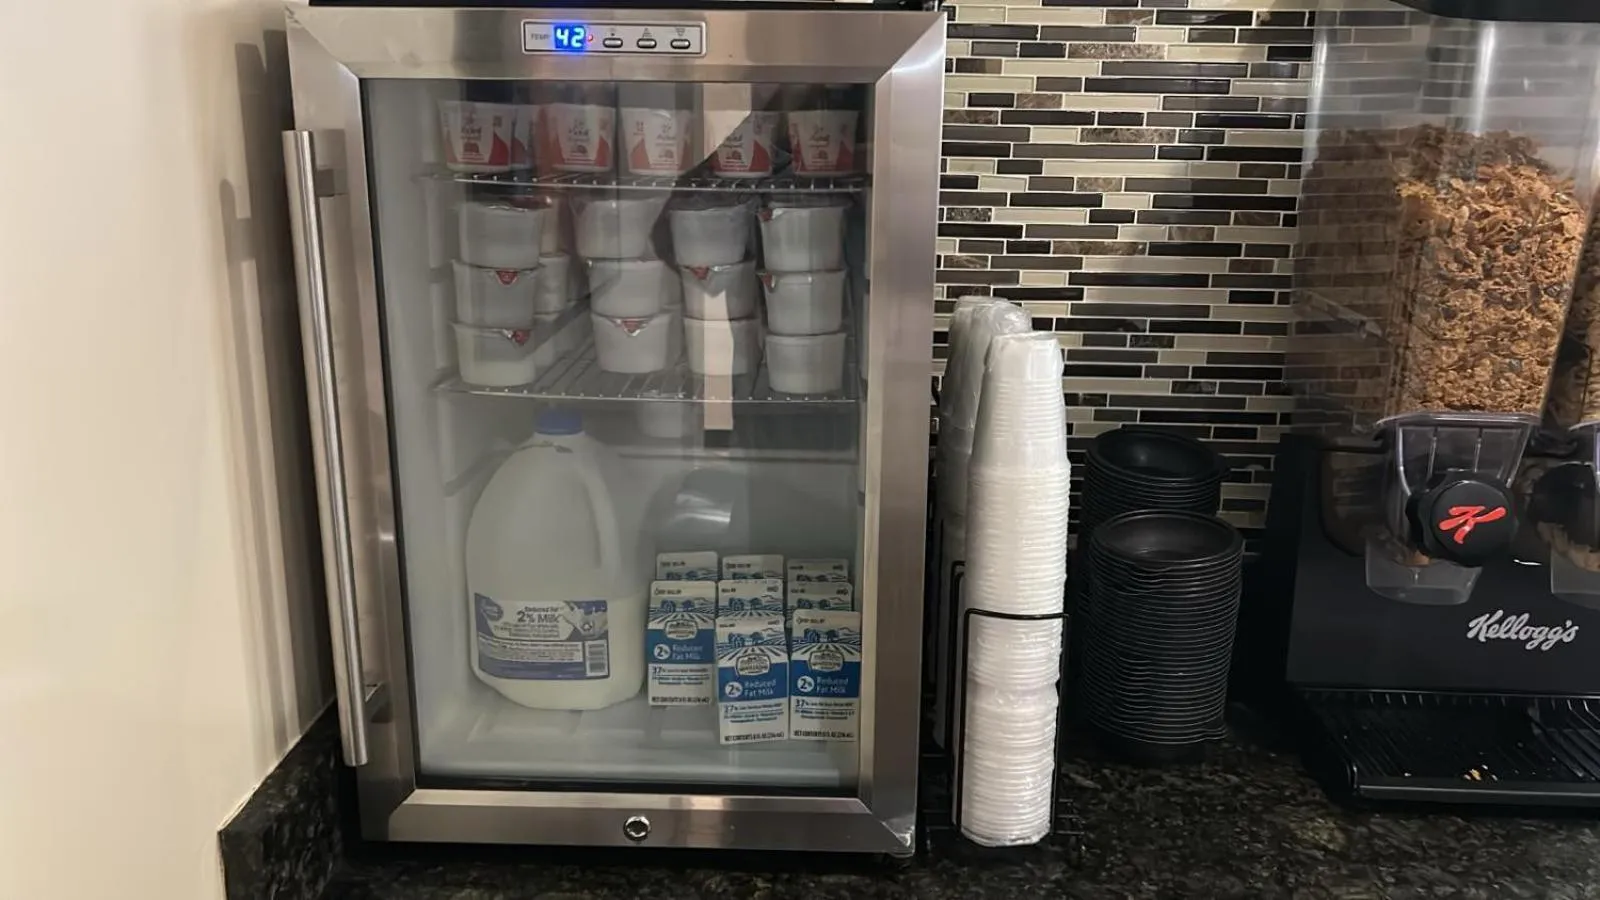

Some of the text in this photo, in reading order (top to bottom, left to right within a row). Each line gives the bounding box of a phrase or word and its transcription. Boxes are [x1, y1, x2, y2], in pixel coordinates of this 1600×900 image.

[555, 26, 584, 48] 42
[516, 609, 535, 623] 2%
[537, 612, 560, 623] Milk
[1466, 609, 1579, 651] Kellogg's
[655, 645, 669, 658] 2%
[672, 644, 703, 652] Reduced
[672, 652, 701, 660] Fat Milk
[744, 678, 776, 688] Reduced
[800, 678, 812, 690] 2%
[816, 676, 848, 685] Reduced
[727, 684, 741, 695] 2%
[744, 687, 774, 697] Fat Milk
[816, 685, 846, 693] Fat Milk
